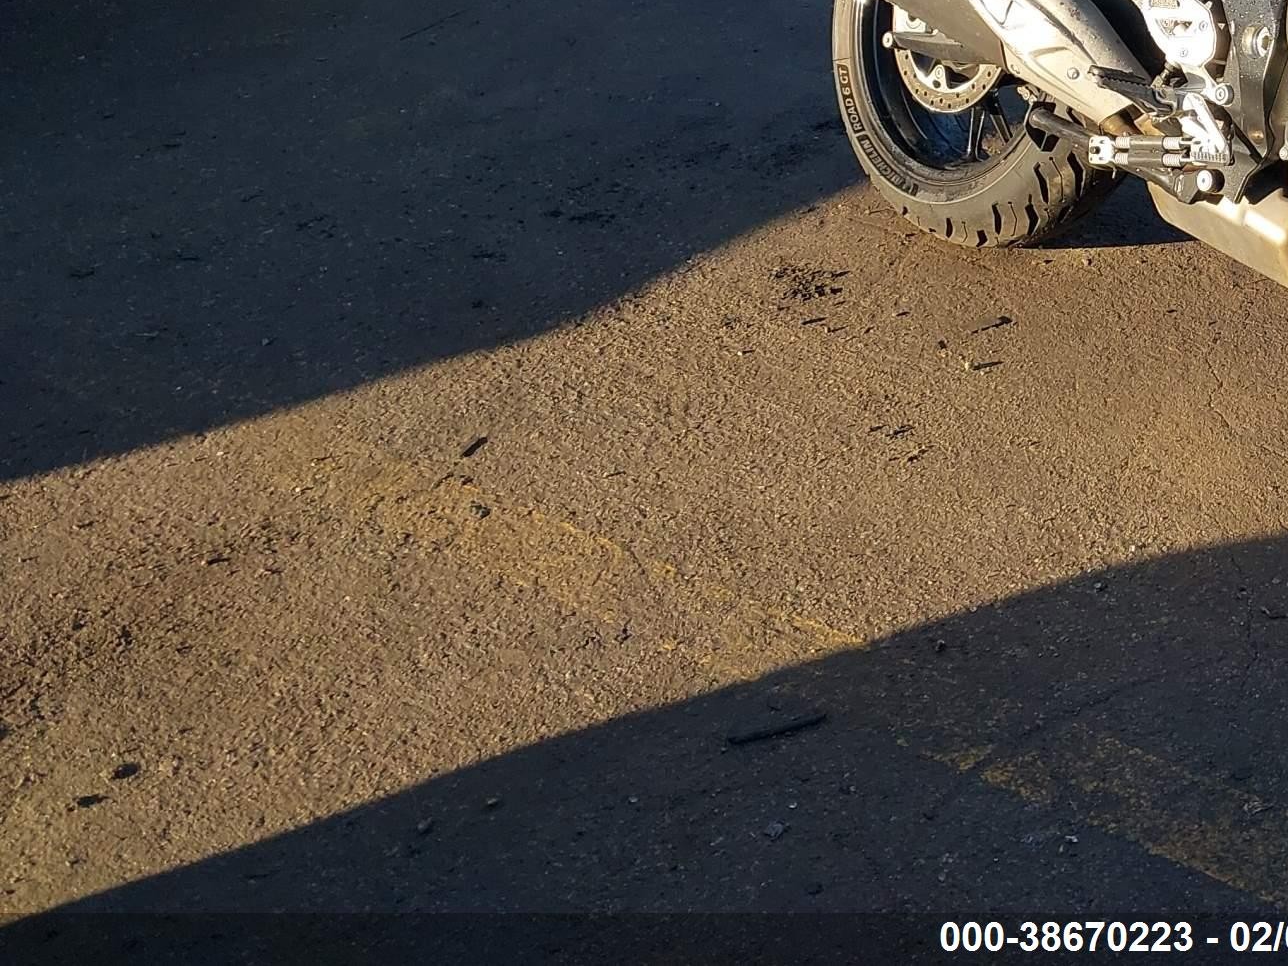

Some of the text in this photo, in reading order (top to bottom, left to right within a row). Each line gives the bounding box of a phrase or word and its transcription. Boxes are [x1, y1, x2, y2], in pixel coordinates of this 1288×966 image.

[838, 67, 849, 83] GT
[845, 100, 864, 131] ROAD
[860, 139, 905, 186] MICHELIN
